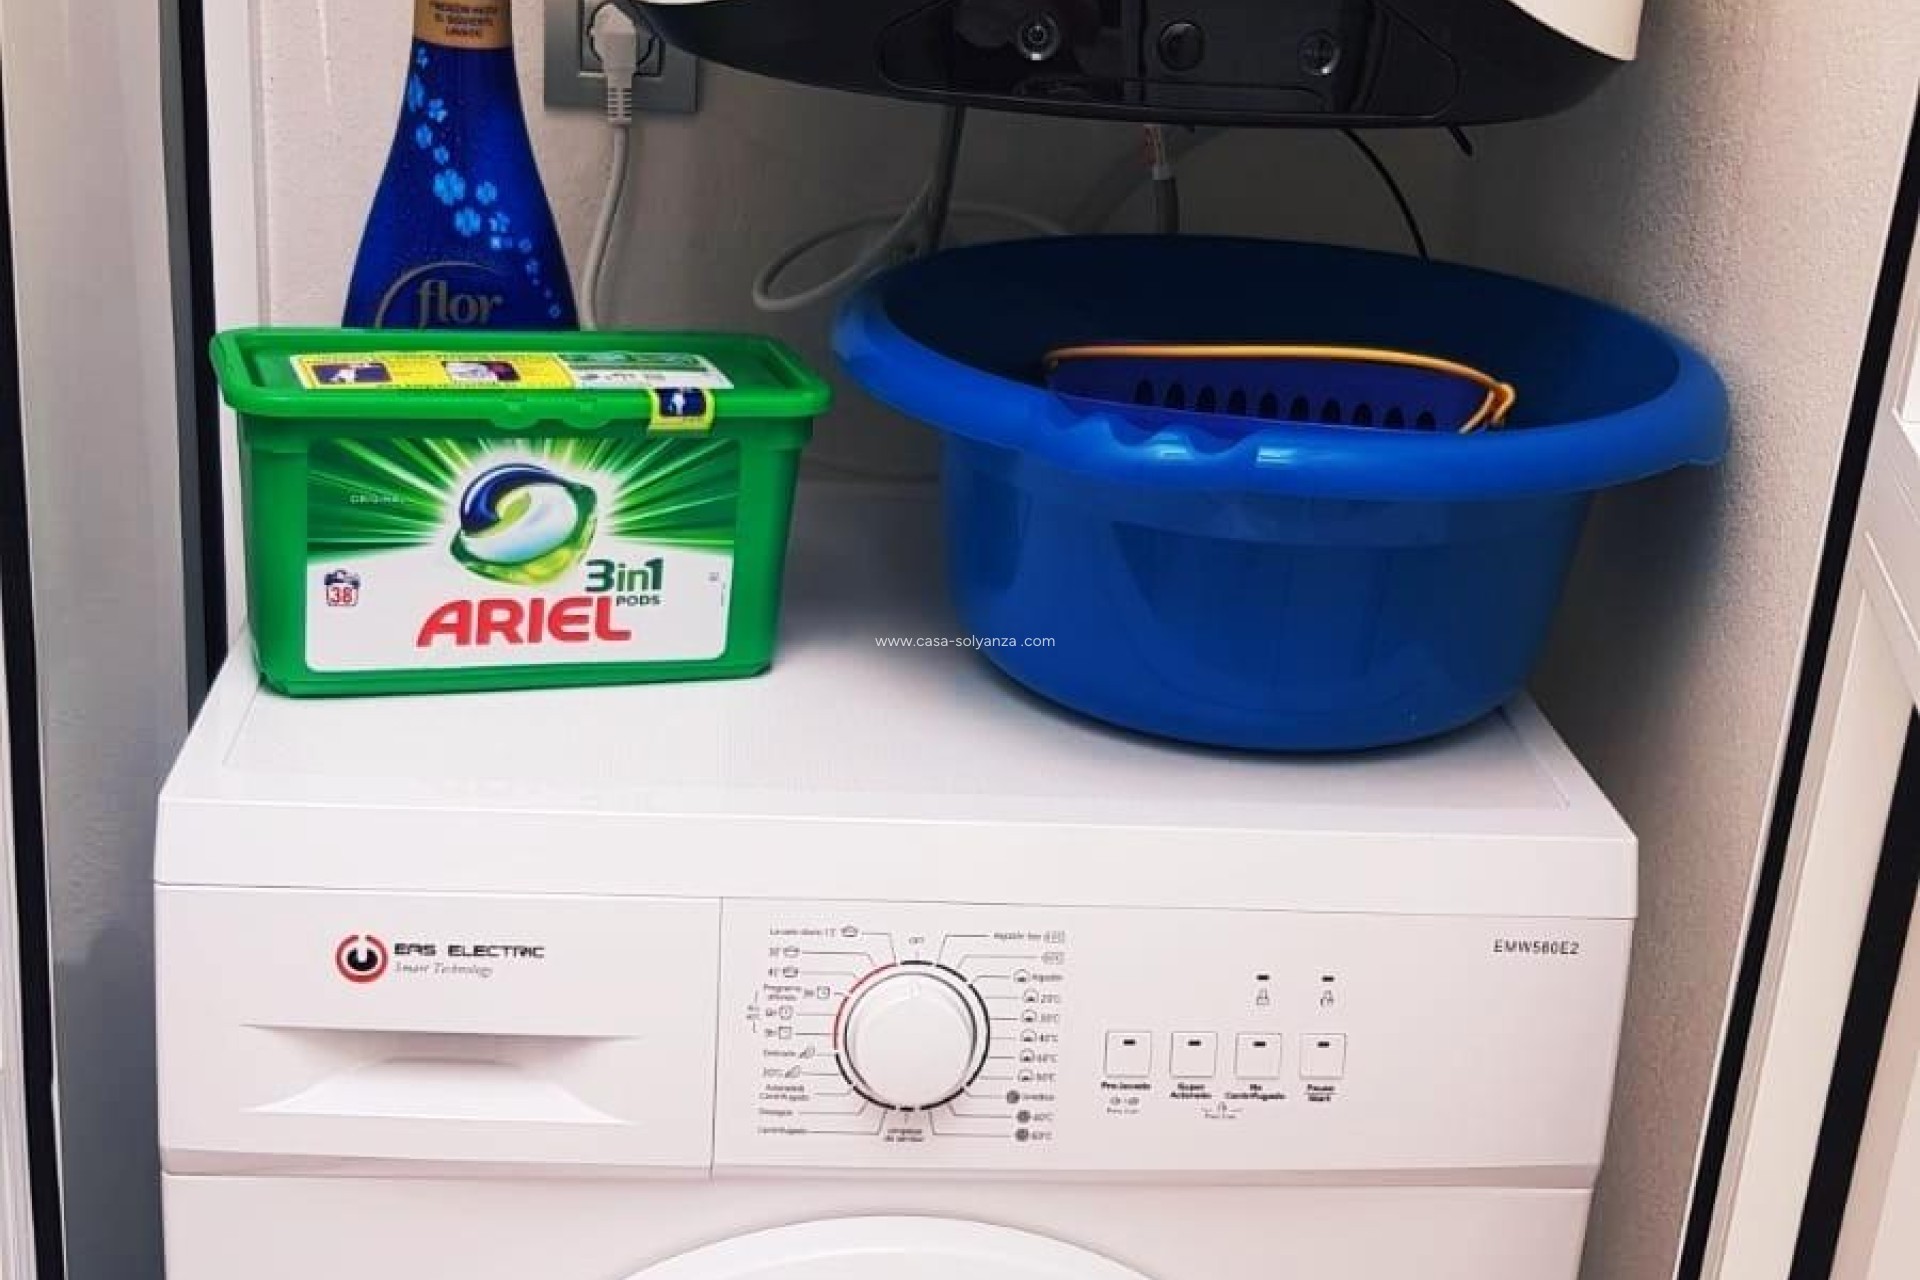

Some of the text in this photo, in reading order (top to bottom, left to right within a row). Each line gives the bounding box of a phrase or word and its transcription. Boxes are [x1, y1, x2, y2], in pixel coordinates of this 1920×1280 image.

[419, 279, 503, 328] flor
[585, 557, 664, 593] 3in1
[330, 586, 353, 603] 38
[616, 595, 661, 607] PODS
[416, 597, 632, 647] ARIEL
[394, 942, 545, 959] EAS ELECTRIC
